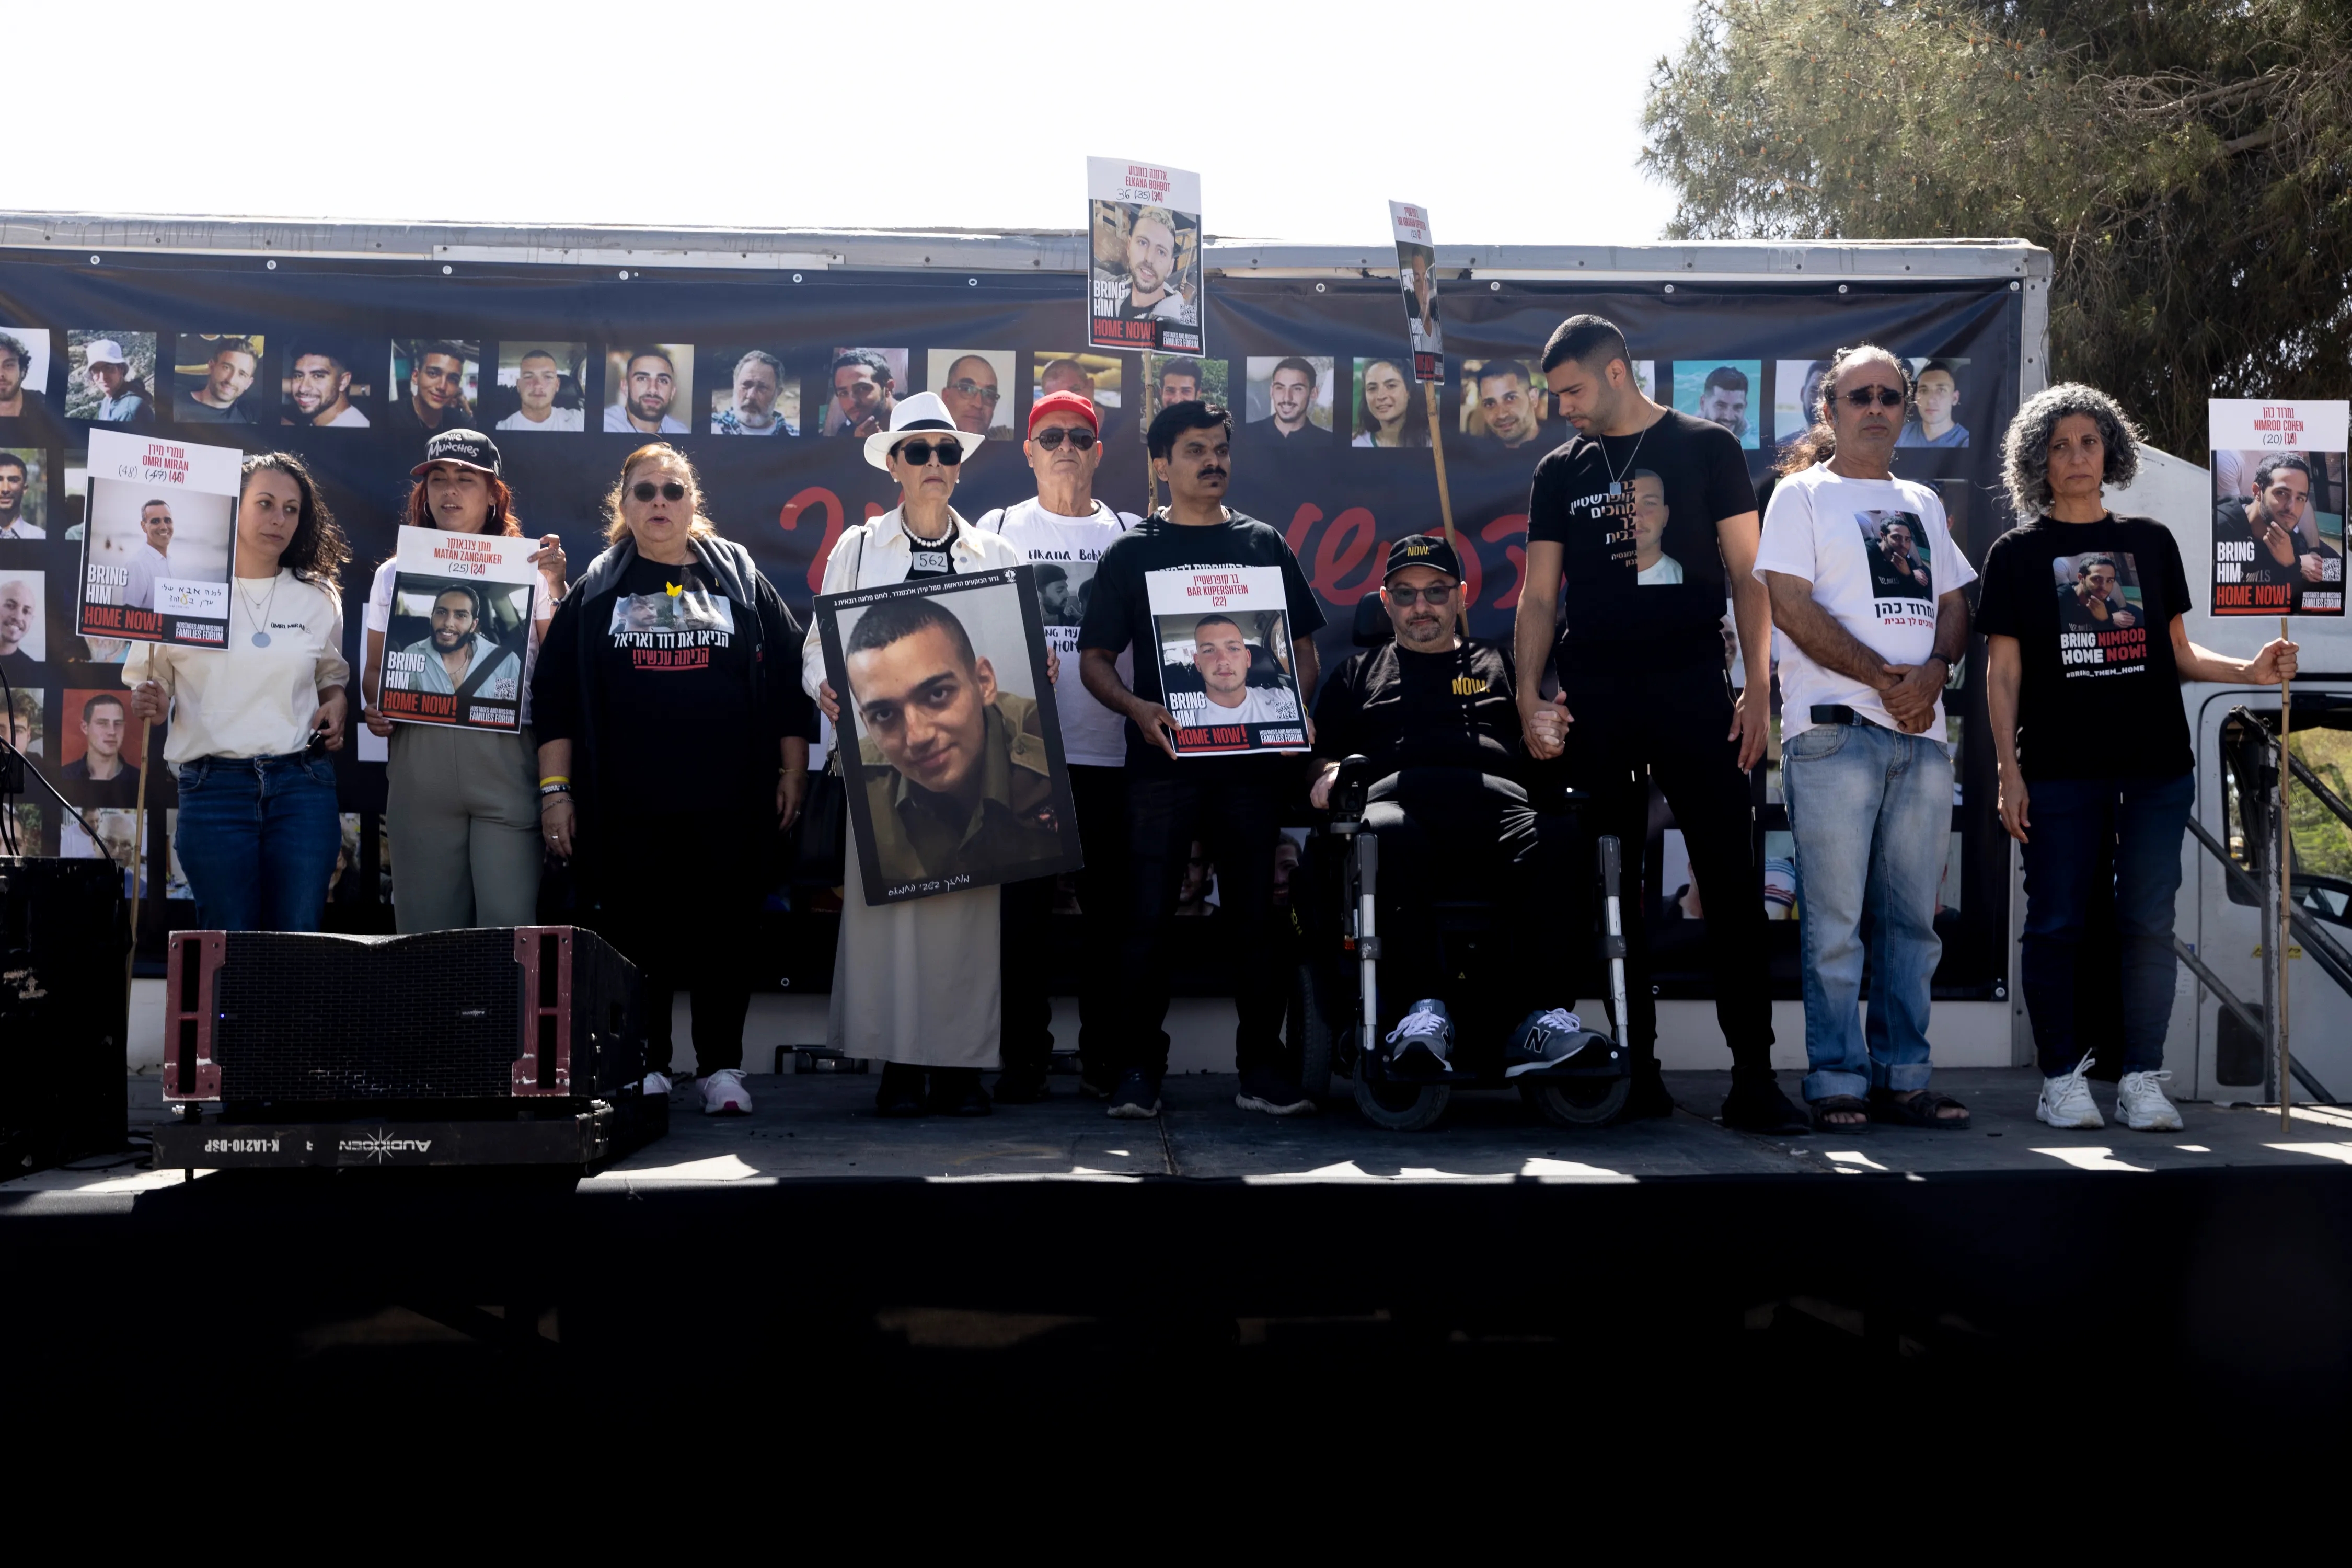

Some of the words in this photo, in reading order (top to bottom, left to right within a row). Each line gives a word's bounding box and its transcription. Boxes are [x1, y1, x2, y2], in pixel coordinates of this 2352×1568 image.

[1128, 165, 1148, 177] בוחבוט
[1149, 168, 1167, 181] אלקנה
[1125, 176, 1148, 188] ELKANA
[1149, 179, 1170, 192] BOHBOT
[1116, 188, 1131, 200] 36
[1134, 189, 1150, 201] (35)
[1094, 280, 1126, 299] BRING
[1094, 297, 1113, 317] HIM
[1094, 318, 1123, 338] HOME
[1126, 320, 1155, 340] NOW!
[1163, 337, 1183, 347] FAMILIES
[1183, 339, 1199, 348] FORUM
[2263, 407, 2274, 419] כהן
[2276, 407, 2294, 418] נמרוד
[2254, 419, 2281, 431] NIMROD
[2283, 420, 2303, 431] COHEN
[2263, 433, 2282, 445] (20)
[148, 444, 164, 456] מירן
[166, 446, 185, 458] עמרי
[142, 455, 162, 468] OMRI
[164, 458, 189, 471] MIRAN
[119, 464, 137, 479] (48)
[1591, 502, 1636, 518] מחכים
[1606, 529, 1637, 544] בבית
[478, 541, 491, 552] מתן
[1407, 545, 1430, 557] NOW.
[2217, 541, 2255, 561] BRING
[434, 548, 458, 560] MATAN
[460, 551, 502, 564] ZANGAUKER
[919, 554, 946, 567] 562
[87, 563, 129, 586] BRING
[448, 562, 469, 574] (25)
[2217, 563, 2241, 583] HIM
[965, 577, 987, 586] הבוקעים
[1193, 574, 1229, 586] קופרשטיין
[1230, 574, 1239, 584] בר
[86, 584, 112, 605] HIM
[178, 586, 200, 595] אבא
[874, 592, 888, 600] לוחם
[892, 588, 916, 597] אלכסנדר
[1187, 586, 1202, 596] BAR
[1203, 585, 1249, 596] KUPERSHTEIN
[2216, 586, 2252, 606] HOME
[2255, 582, 2291, 605] NOW!
[838, 597, 857, 606] רובאית
[858, 594, 873, 603] פלוגה
[1212, 596, 1227, 607] (22)
[2302, 598, 2324, 608] FAMILIES
[2324, 598, 2342, 608] FORUM
[1874, 602, 1903, 618] כהן
[84, 605, 122, 628] HOME
[125, 609, 163, 632] NOW!
[176, 621, 197, 631] HOSTAGES
[1907, 617, 1916, 626] לך
[176, 628, 202, 639] FAMILIES
[202, 630, 224, 641] FORUM
[614, 633, 653, 648] ואריאל
[656, 633, 675, 648] דוד
[677, 631, 694, 648] את
[697, 630, 729, 648] הביאו
[2060, 632, 2096, 649] BRING
[2097, 628, 2146, 647] NIMROD
[388, 651, 426, 672] BRING
[632, 649, 672, 666] עכשיו!
[674, 648, 709, 666] הביתה
[2061, 649, 2104, 665] HOME
[2106, 644, 2147, 662] NOW!
[385, 671, 410, 690] HIM
[1452, 677, 1490, 695] NOW.
[384, 690, 419, 712] HOME
[421, 694, 458, 716] NOW!
[1169, 691, 1206, 710] BRING
[469, 711, 494, 722] FAMILIES
[494, 714, 515, 724] FORUM
[1172, 710, 1196, 727] HIM
[1177, 728, 1211, 745] HOME
[1211, 724, 1248, 743] NOW!
[1260, 734, 1285, 743] FAMILIES
[1285, 733, 1304, 742] FORUM
[1524, 1025, 1551, 1054] N
[204, 1138, 279, 1153] K-LA210-DSP
